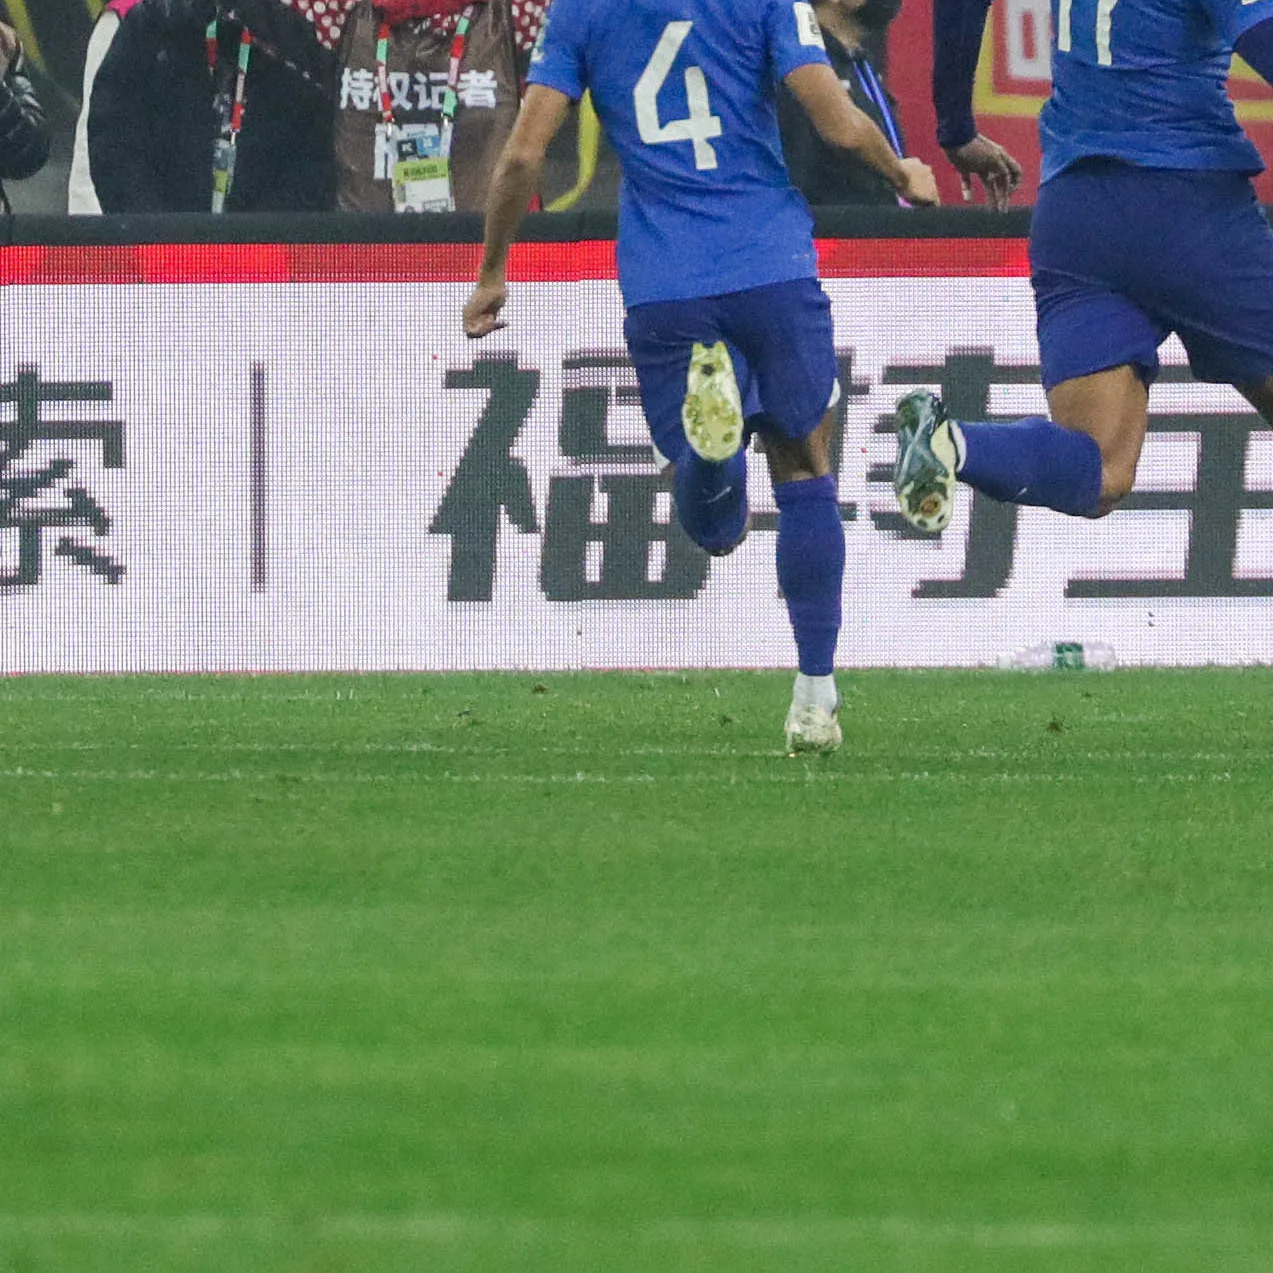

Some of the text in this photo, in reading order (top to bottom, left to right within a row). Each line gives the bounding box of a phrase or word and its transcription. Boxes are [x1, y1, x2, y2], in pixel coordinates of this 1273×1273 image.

[339, 67, 498, 111] 持权记者
[633, 20, 722, 170] 4
